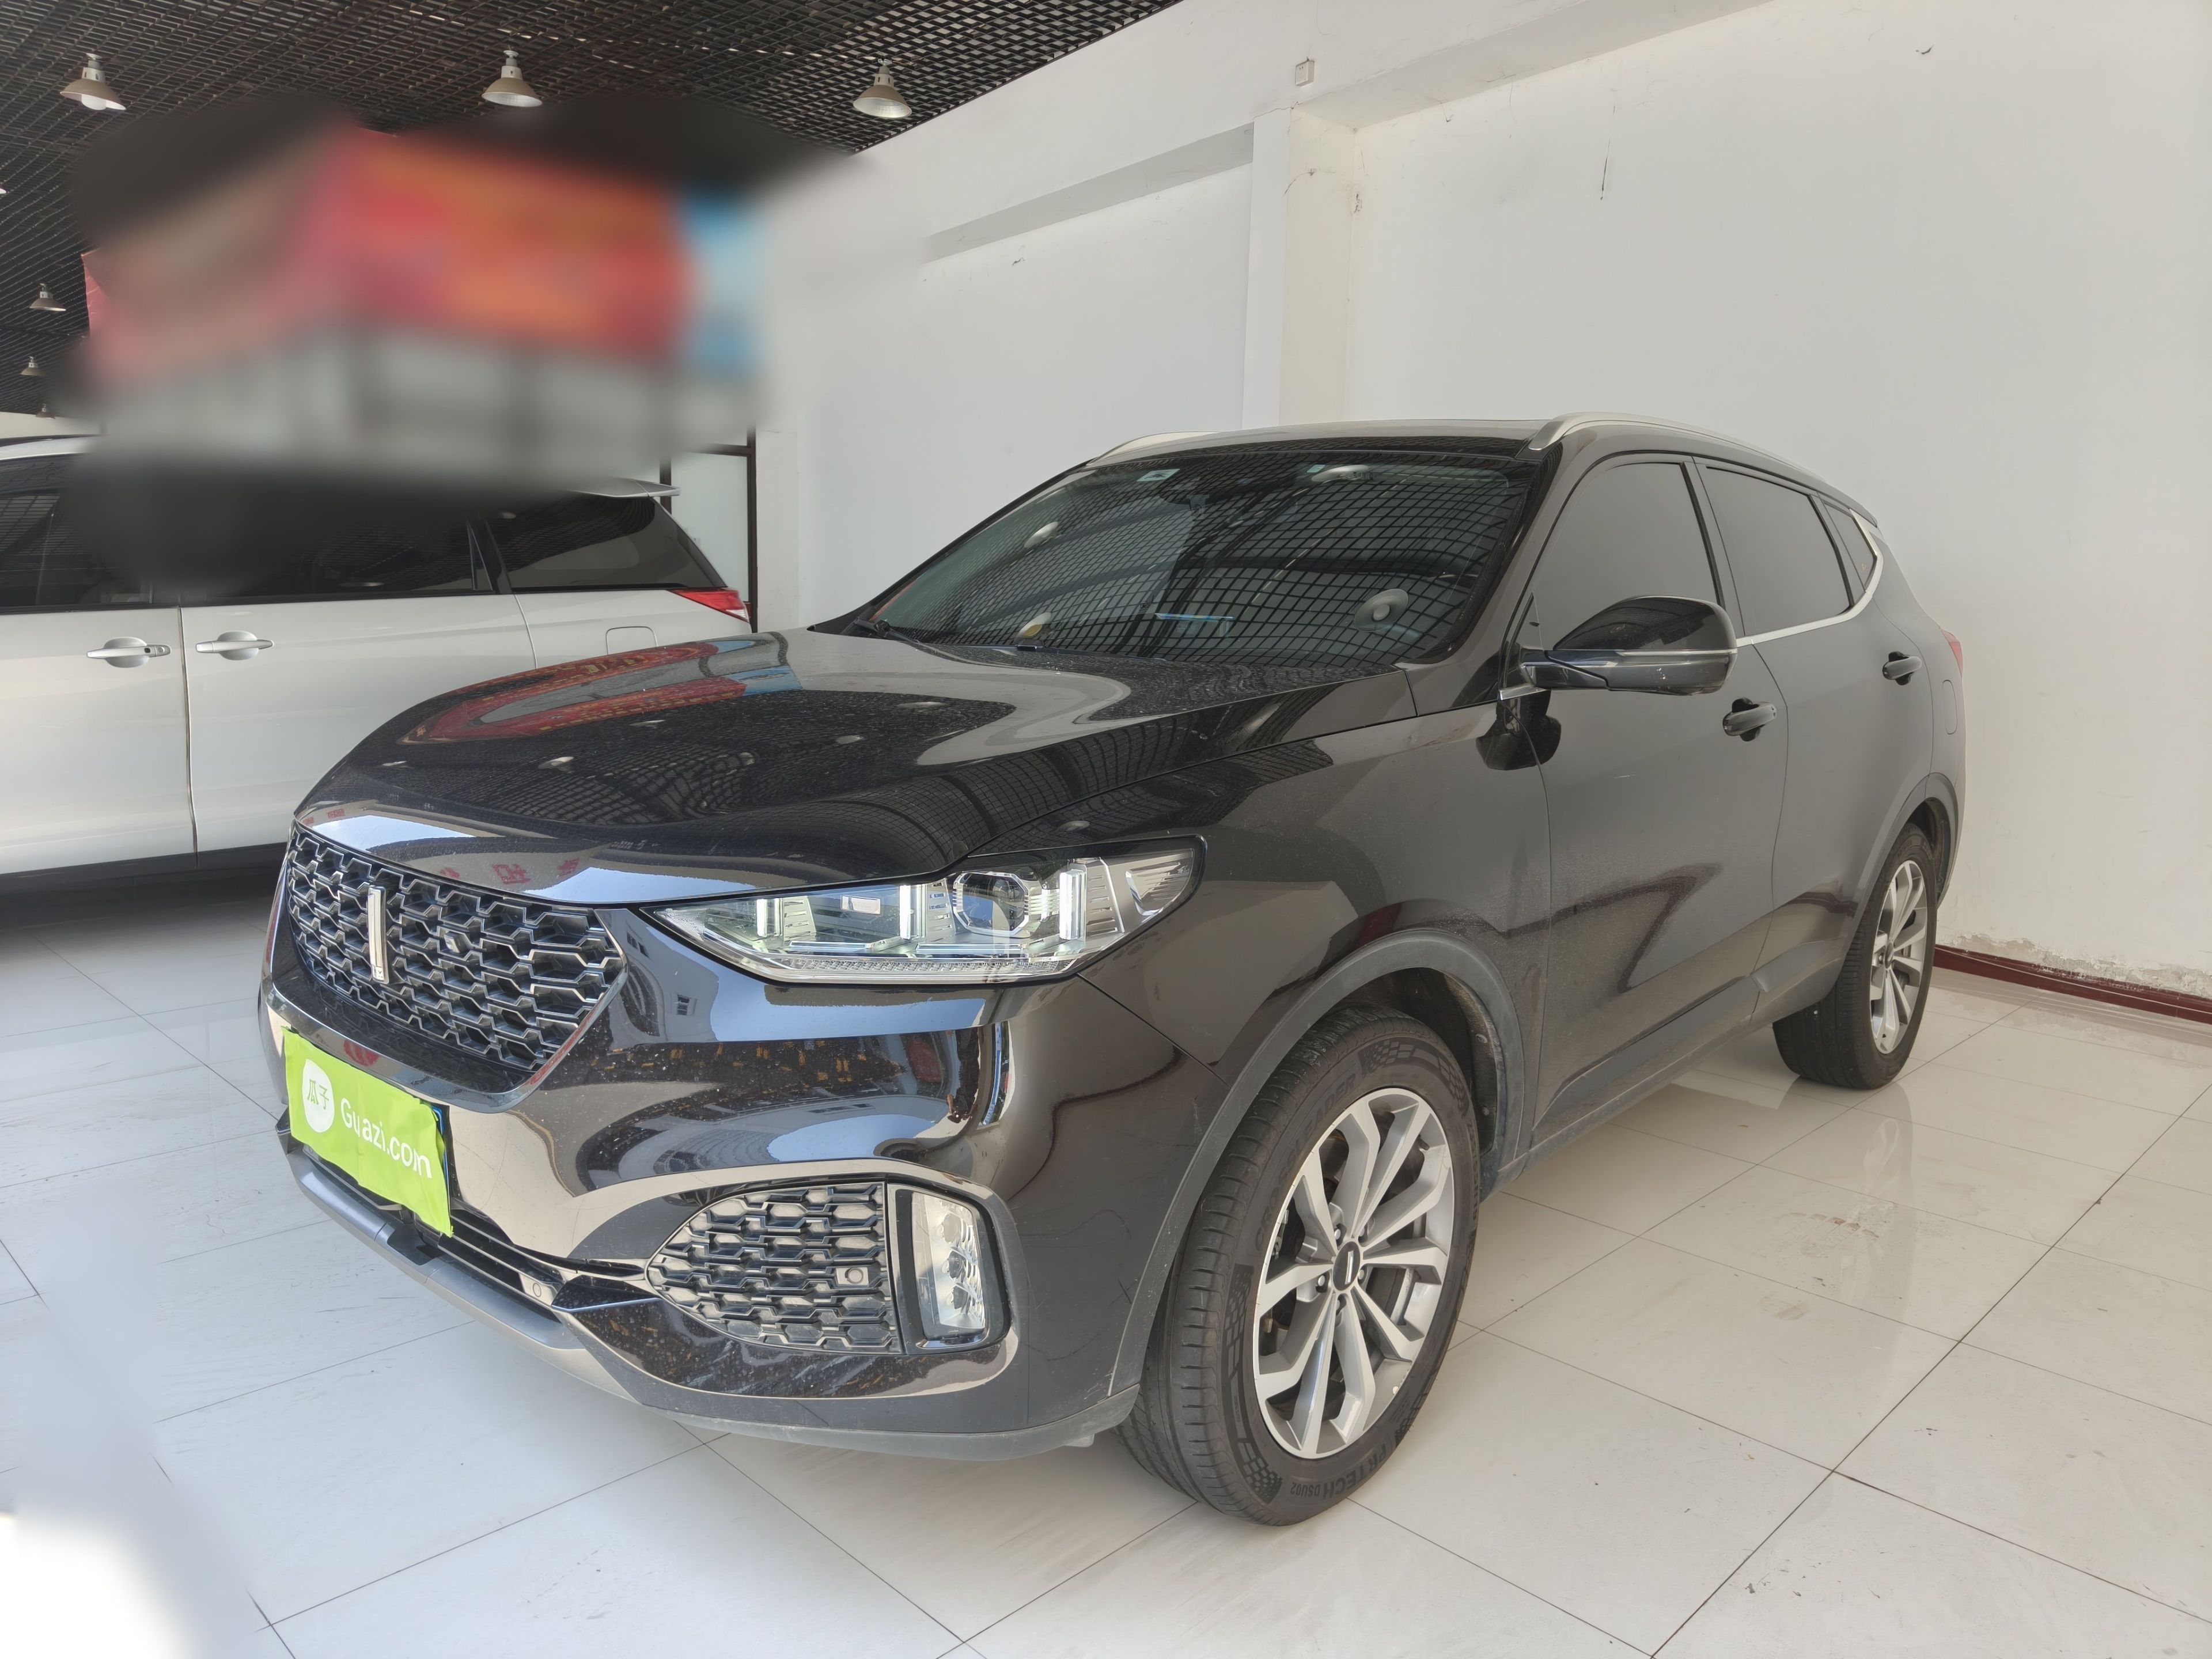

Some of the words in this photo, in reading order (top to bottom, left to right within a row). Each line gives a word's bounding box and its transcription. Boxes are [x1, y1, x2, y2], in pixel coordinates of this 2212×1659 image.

[306, 1078, 329, 1111] 瓜子
[340, 1097, 432, 1179] Guazi.com
[1256, 1073, 1357, 1251] CROSSLEADER
[1290, 1480, 1320, 1498] DSU02
